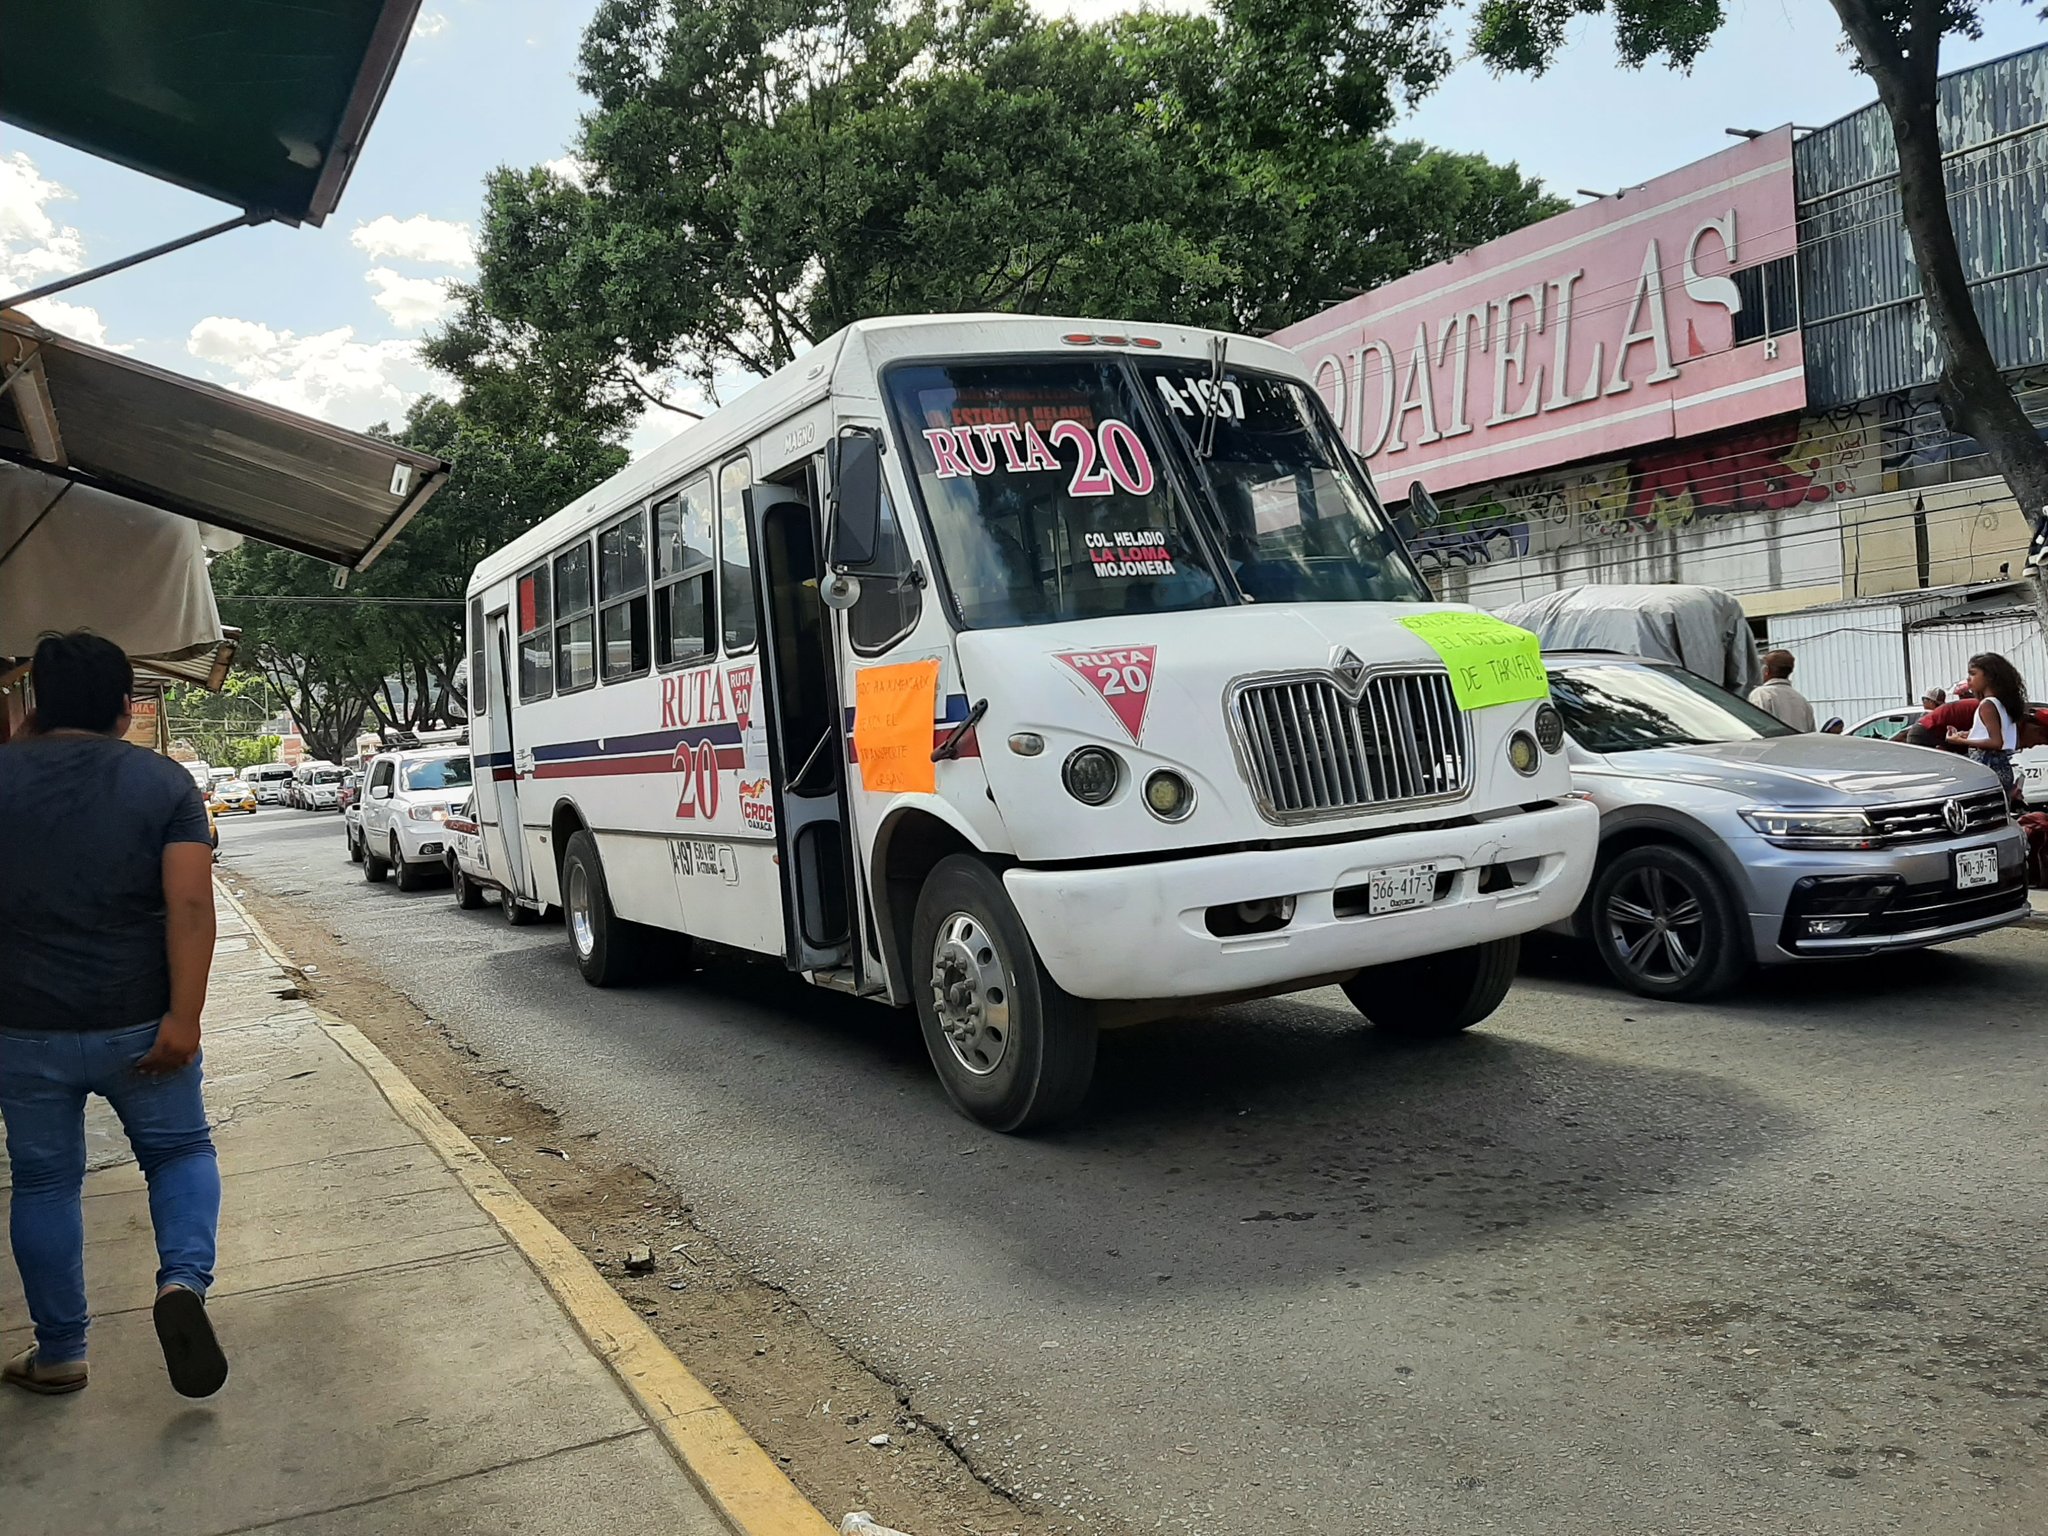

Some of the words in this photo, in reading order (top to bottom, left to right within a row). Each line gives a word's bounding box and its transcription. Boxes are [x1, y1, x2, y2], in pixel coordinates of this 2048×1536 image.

[1764, 339, 1778, 361] R
[1155, 376, 1245, 419] A-197
[922, 421, 1062, 479] RUTA
[1049, 419, 1154, 497] 20
[1085, 533, 1114, 547] COL.
[1114, 531, 1165, 546] HELADIO
[1089, 548, 1116, 562] LA
[1117, 547, 1171, 561] LOMA
[1093, 561, 1176, 577] MOJONERA
[1071, 651, 1149, 668] RUTA
[731, 671, 752, 687] RUTA
[1097, 665, 1147, 695] 20
[1460, 666, 1482, 692] DE
[661, 666, 727, 728] RUTA
[735, 690, 749, 715] 20
[673, 739, 720, 821] 20
[745, 802, 773, 822] CROC
[748, 819, 773, 832] OAXACA
[1373, 874, 1434, 900] 366-417-S
